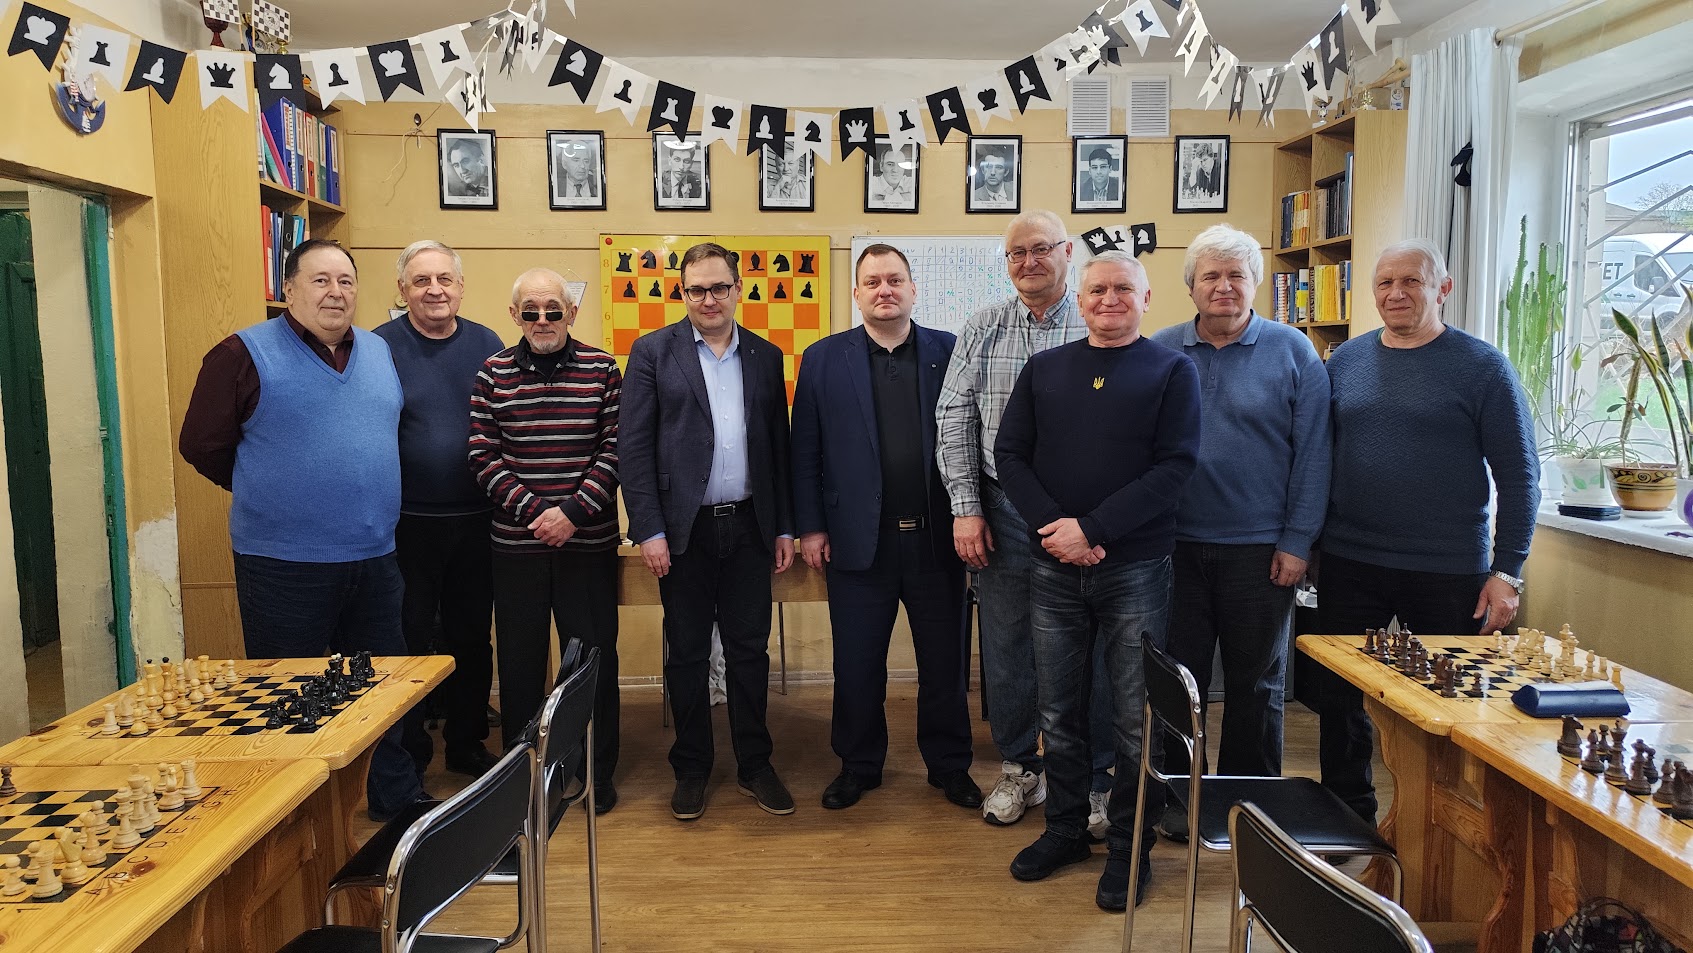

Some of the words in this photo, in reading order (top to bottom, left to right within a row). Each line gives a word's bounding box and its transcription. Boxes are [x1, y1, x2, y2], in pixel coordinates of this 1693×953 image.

[603, 259, 610, 268] 8
[1602, 262, 1624, 280] ET
[603, 285, 610, 294] 7
[604, 311, 611, 320] 6
[605, 337, 612, 346] 5
[103, 871, 128, 879] B
[127, 855, 149, 864] C
[145, 840, 168, 849] D
[201, 801, 221, 809] G
